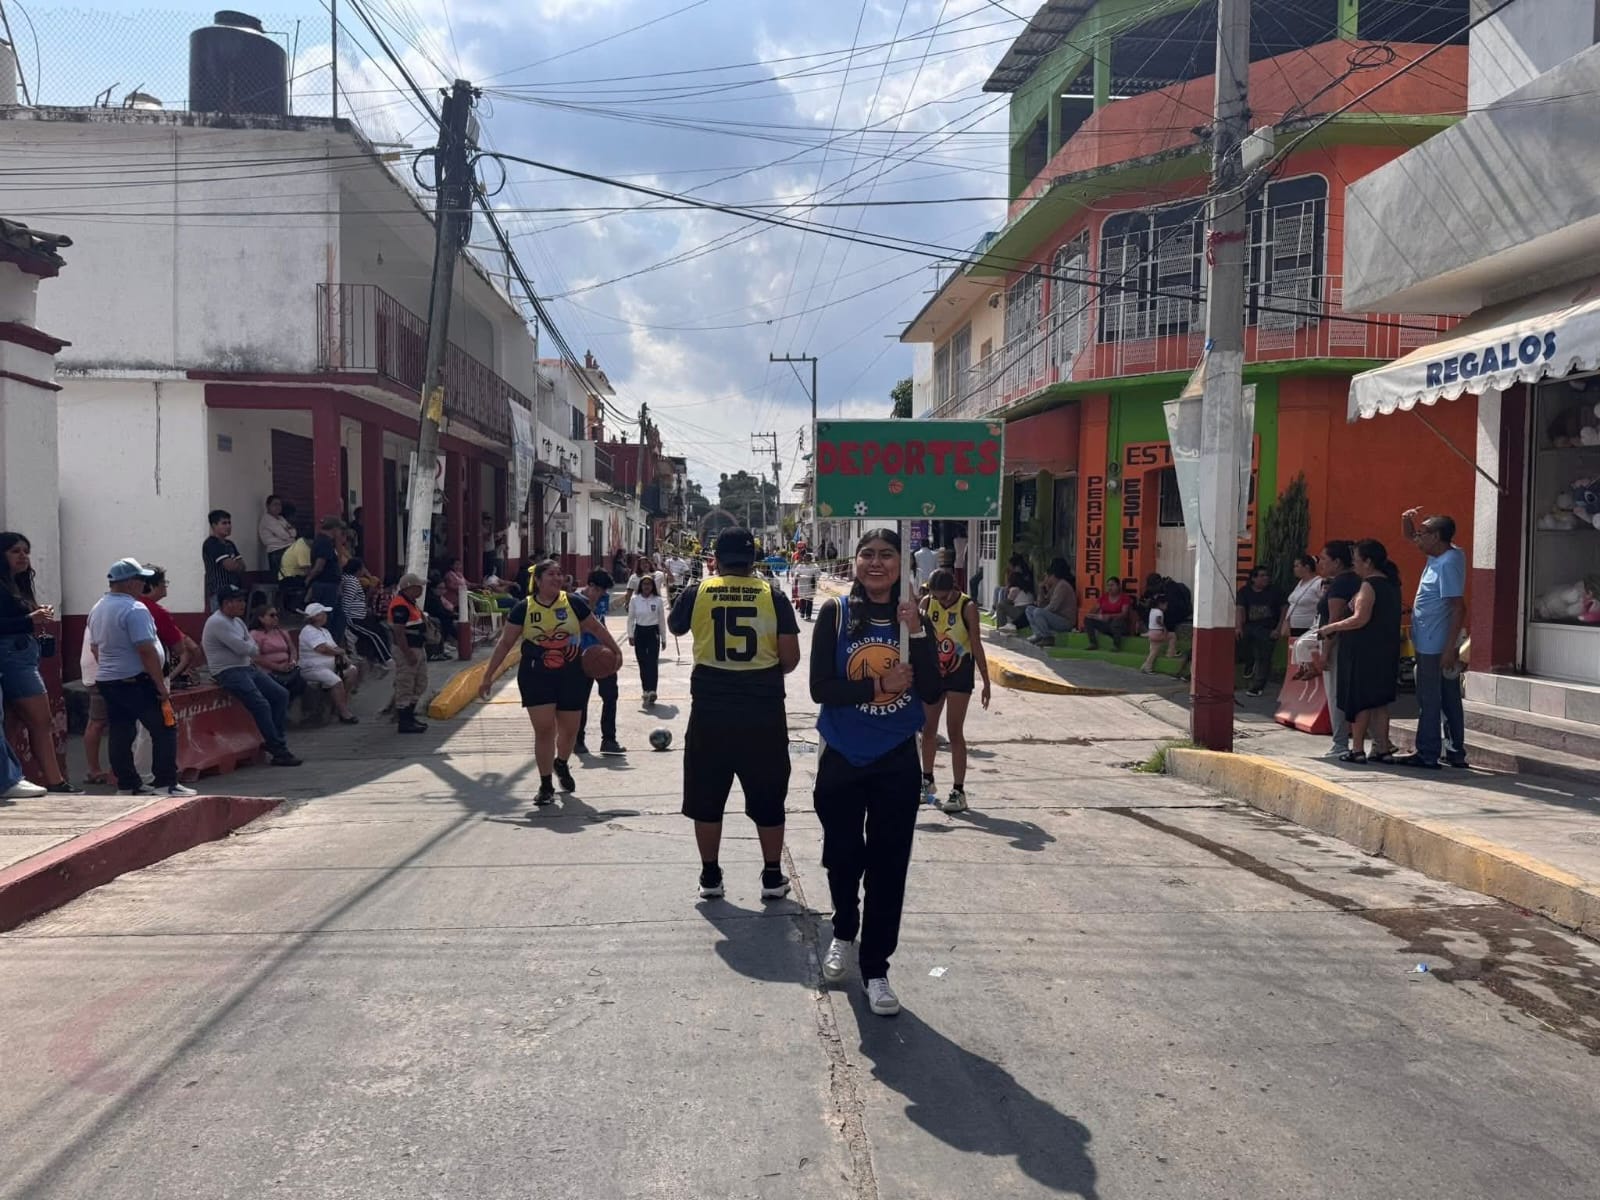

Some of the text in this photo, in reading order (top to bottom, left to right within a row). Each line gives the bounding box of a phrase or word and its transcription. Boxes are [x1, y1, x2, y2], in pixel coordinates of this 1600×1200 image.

[1426, 330, 1557, 389] REGALOS
[816, 440, 1000, 475] DEPORTES
[1121, 478, 1142, 595] ESTETIC
[530, 612, 541, 623] 10
[932, 611, 939, 622] 8
[711, 606, 757, 662] 15
[846, 636, 882, 653] GOLDEN
[855, 693, 912, 715] RRIORS
